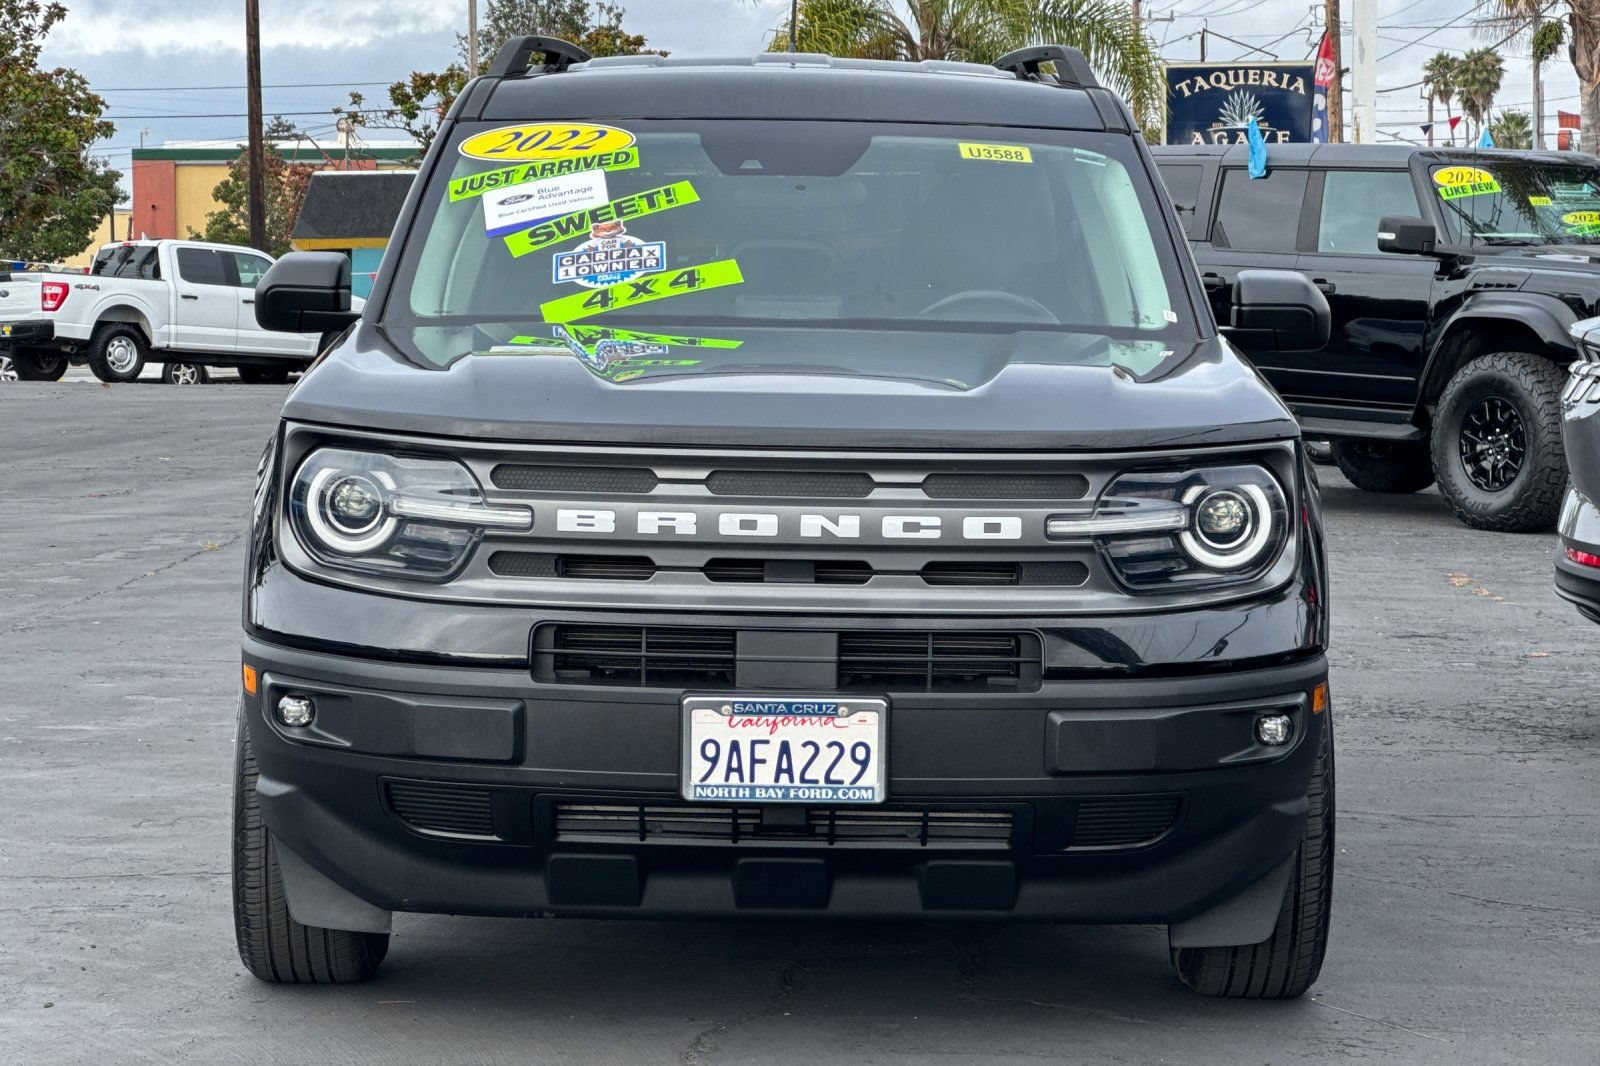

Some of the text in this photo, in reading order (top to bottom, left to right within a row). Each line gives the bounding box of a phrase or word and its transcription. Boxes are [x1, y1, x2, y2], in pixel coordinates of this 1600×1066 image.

[1175, 69, 1306, 97] TAQUERIA
[484, 129, 608, 154] 2022
[969, 147, 1024, 161] U3588
[453, 149, 633, 196] JUST ARRIVED
[1446, 171, 1483, 184] 2023
[537, 185, 560, 195] Blue
[538, 185, 593, 201] Advantage
[1444, 181, 1493, 197] LIKE NEW
[548, 199, 567, 208] Used
[527, 186, 679, 247] SWEET!
[561, 248, 657, 266] CARFAX
[562, 259, 657, 277] 1 OWNER
[556, 508, 1022, 540] BRONCO
[734, 703, 837, 715] SANTA CRUZ
[727, 715, 849, 735] California
[699, 738, 871, 786] 9AFA229
[696, 786, 873, 800] NORTH BAY FORD.COM
